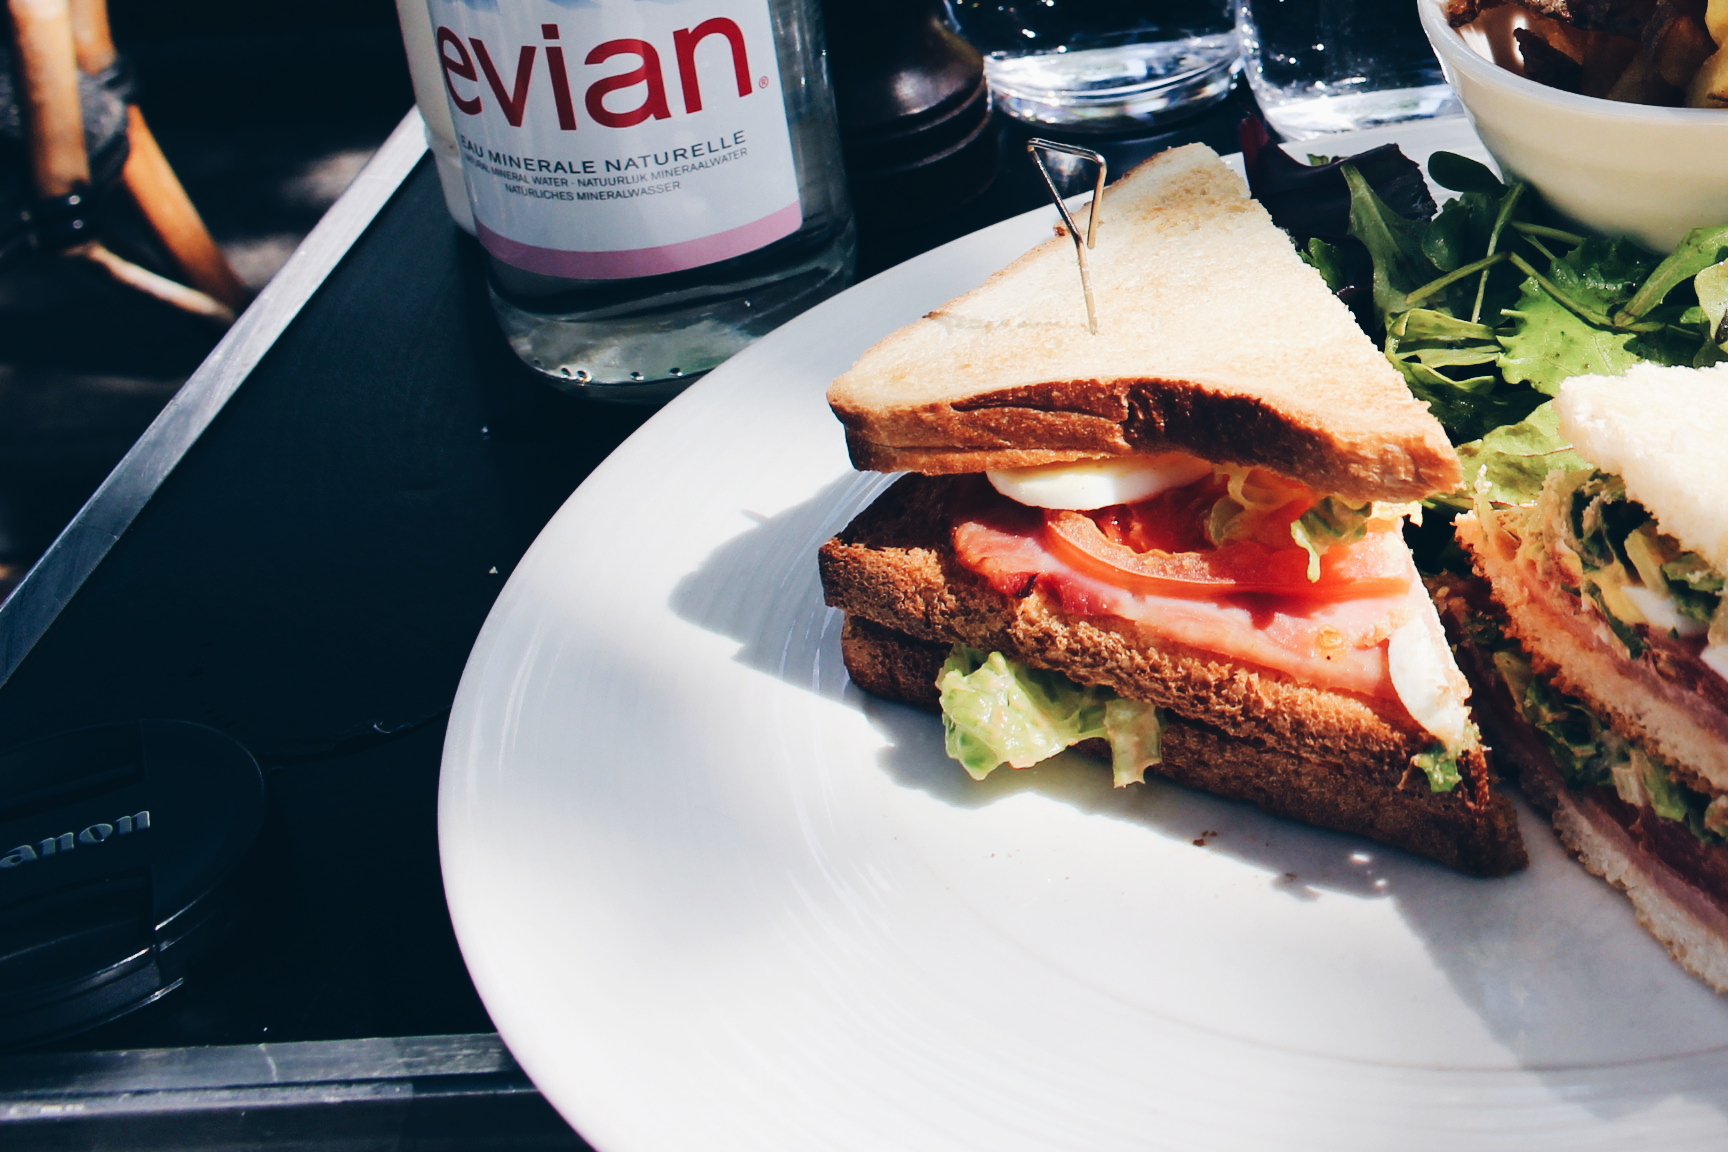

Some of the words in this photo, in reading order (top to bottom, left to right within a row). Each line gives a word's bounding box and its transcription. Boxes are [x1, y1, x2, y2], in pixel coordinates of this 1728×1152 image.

[437, 17, 753, 131] evian
[460, 134, 484, 158] EAU
[488, 149, 597, 174] MINERALE
[605, 130, 746, 173] NATURELLE
[531, 175, 568, 187] WATER
[577, 173, 648, 188] NATUURLIJK
[651, 147, 748, 181] MINERAALWATER
[577, 181, 681, 201] MINERALWASSER
[0, 811, 150, 868] anon
